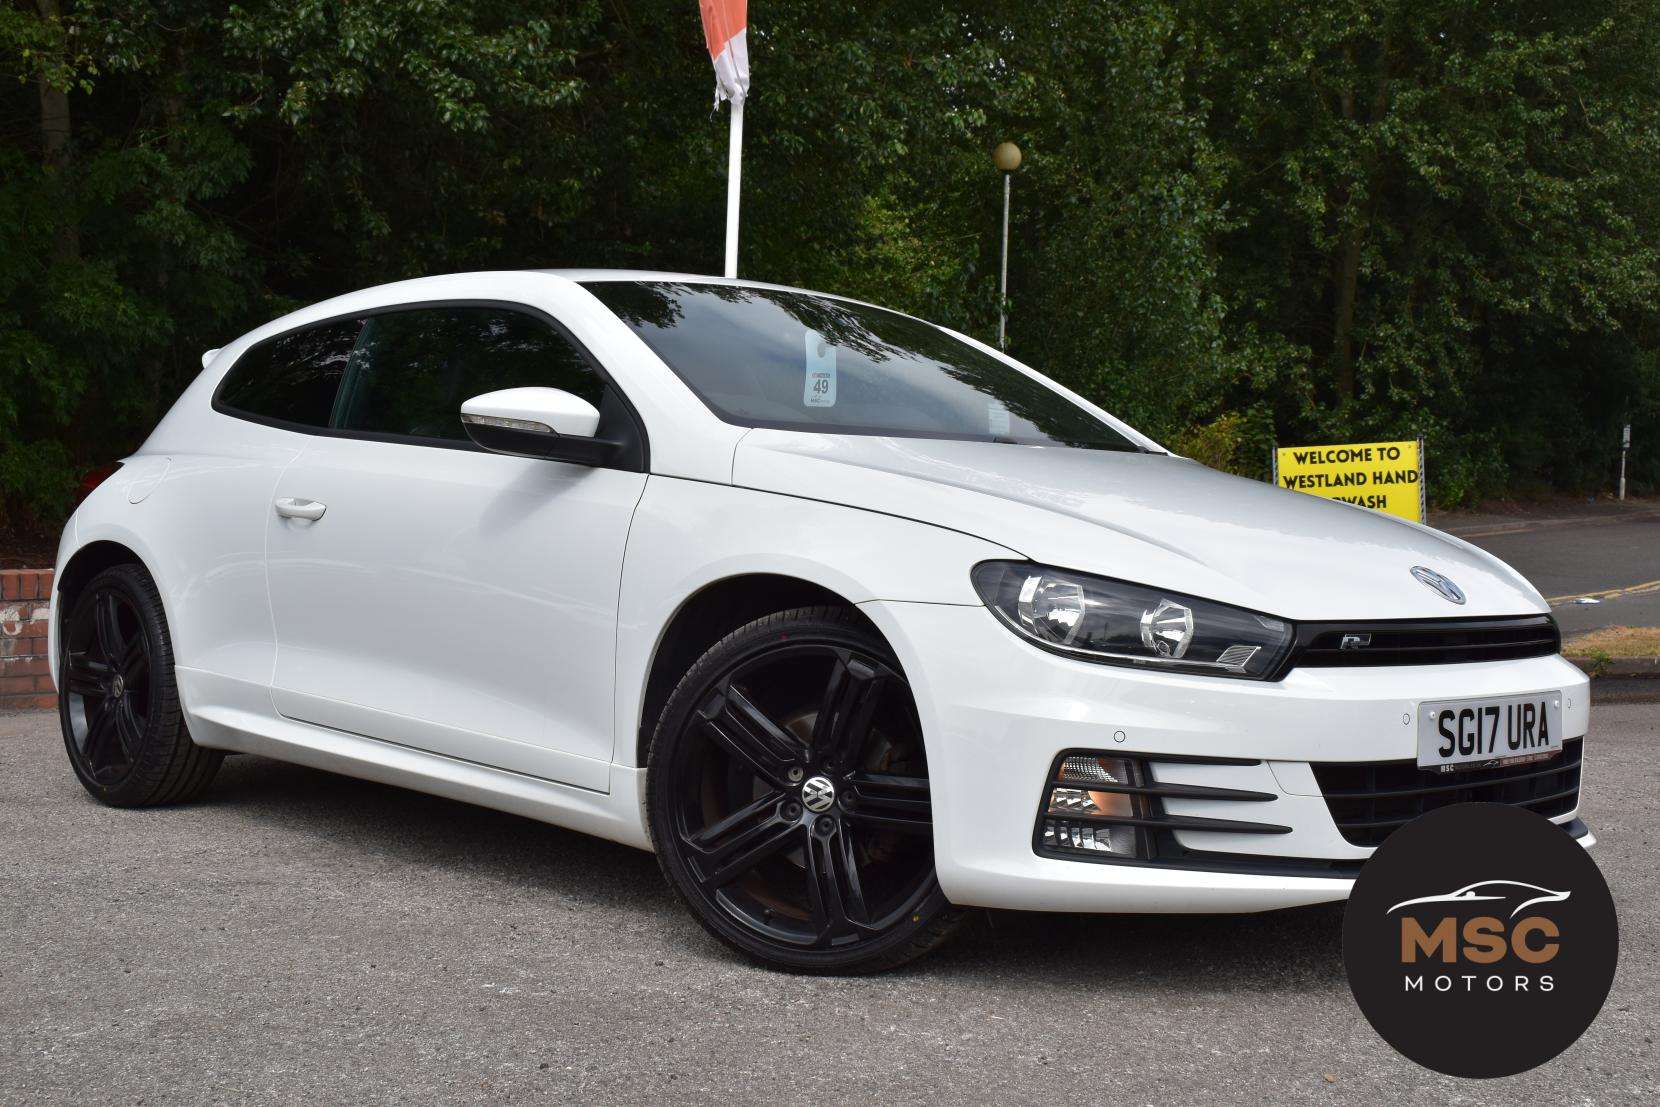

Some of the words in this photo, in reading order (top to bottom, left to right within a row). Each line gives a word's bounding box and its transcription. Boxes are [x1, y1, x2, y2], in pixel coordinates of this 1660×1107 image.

[813, 379, 829, 394] 49
[1293, 448, 1372, 465] WELCOME
[1376, 447, 1400, 461] TO
[1282, 472, 1367, 490] WESTLAND
[1373, 470, 1418, 485] HAND
[1332, 495, 1387, 509] WASH
[1438, 706, 1500, 758] SG17
[1508, 702, 1549, 751] URA
